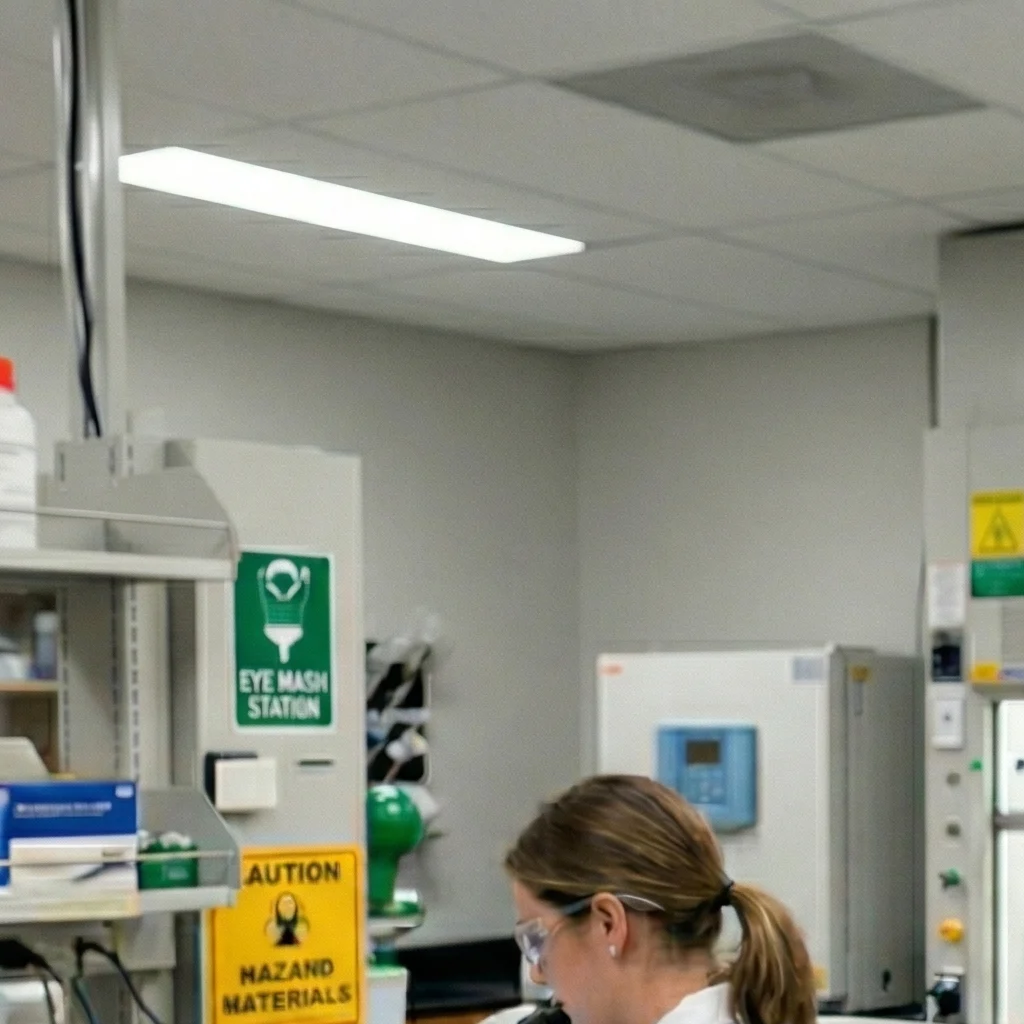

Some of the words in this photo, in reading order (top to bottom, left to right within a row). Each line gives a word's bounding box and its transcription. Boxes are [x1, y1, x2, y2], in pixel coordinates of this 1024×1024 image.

[239, 668, 275, 693] EYE
[247, 694, 320, 719] STATION
[243, 861, 341, 886] AUTION
[222, 984, 352, 1015] MATERIALS
